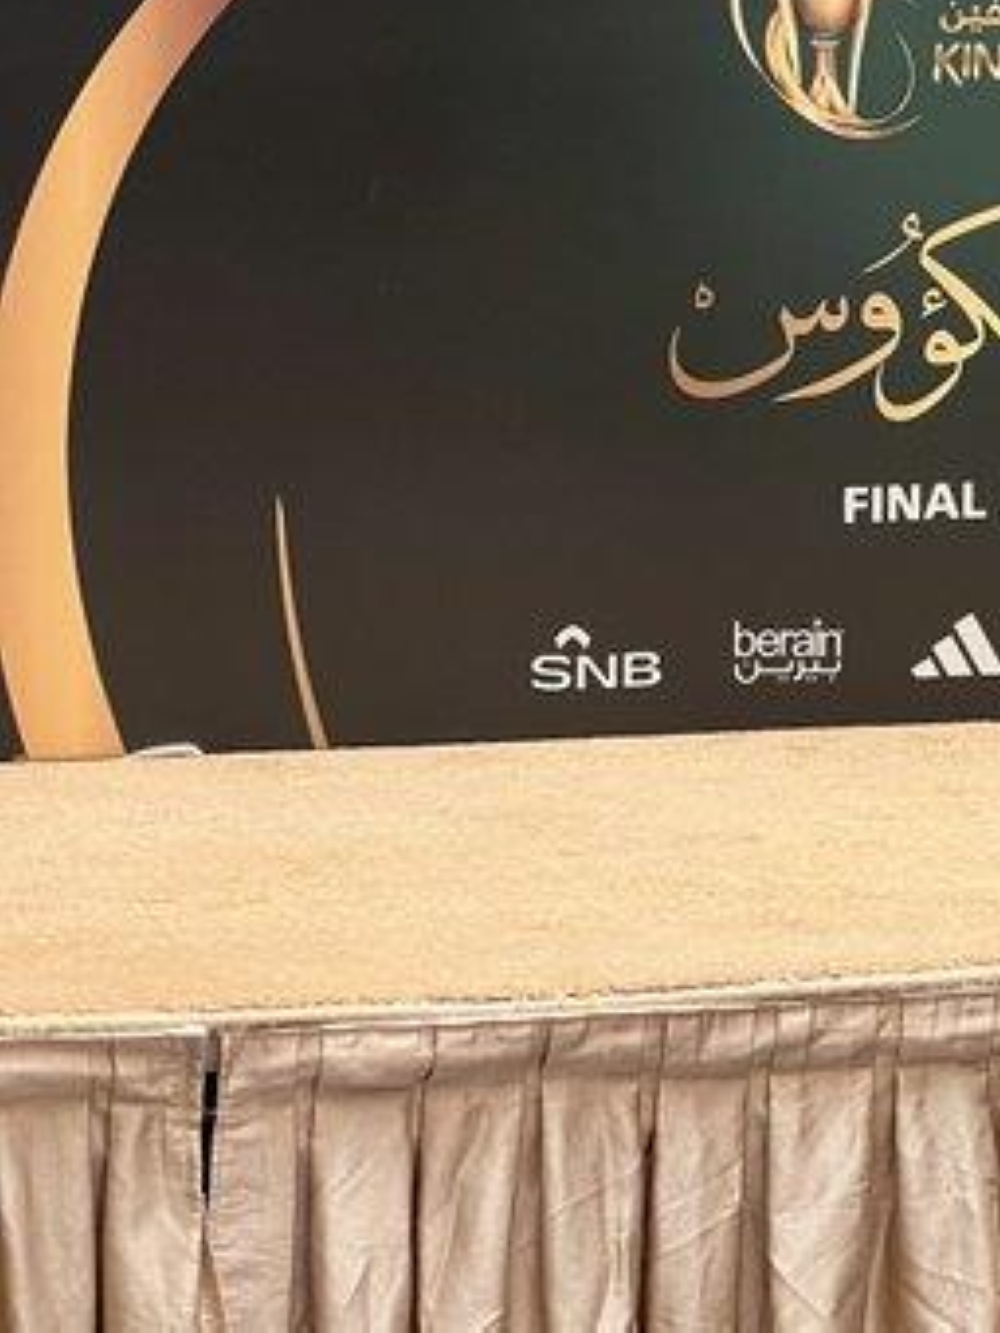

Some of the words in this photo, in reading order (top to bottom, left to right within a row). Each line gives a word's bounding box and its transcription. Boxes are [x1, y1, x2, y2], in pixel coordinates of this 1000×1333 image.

[843, 484, 986, 524] FINAL
[733, 618, 843, 657] berain
[531, 651, 662, 690] SNB
